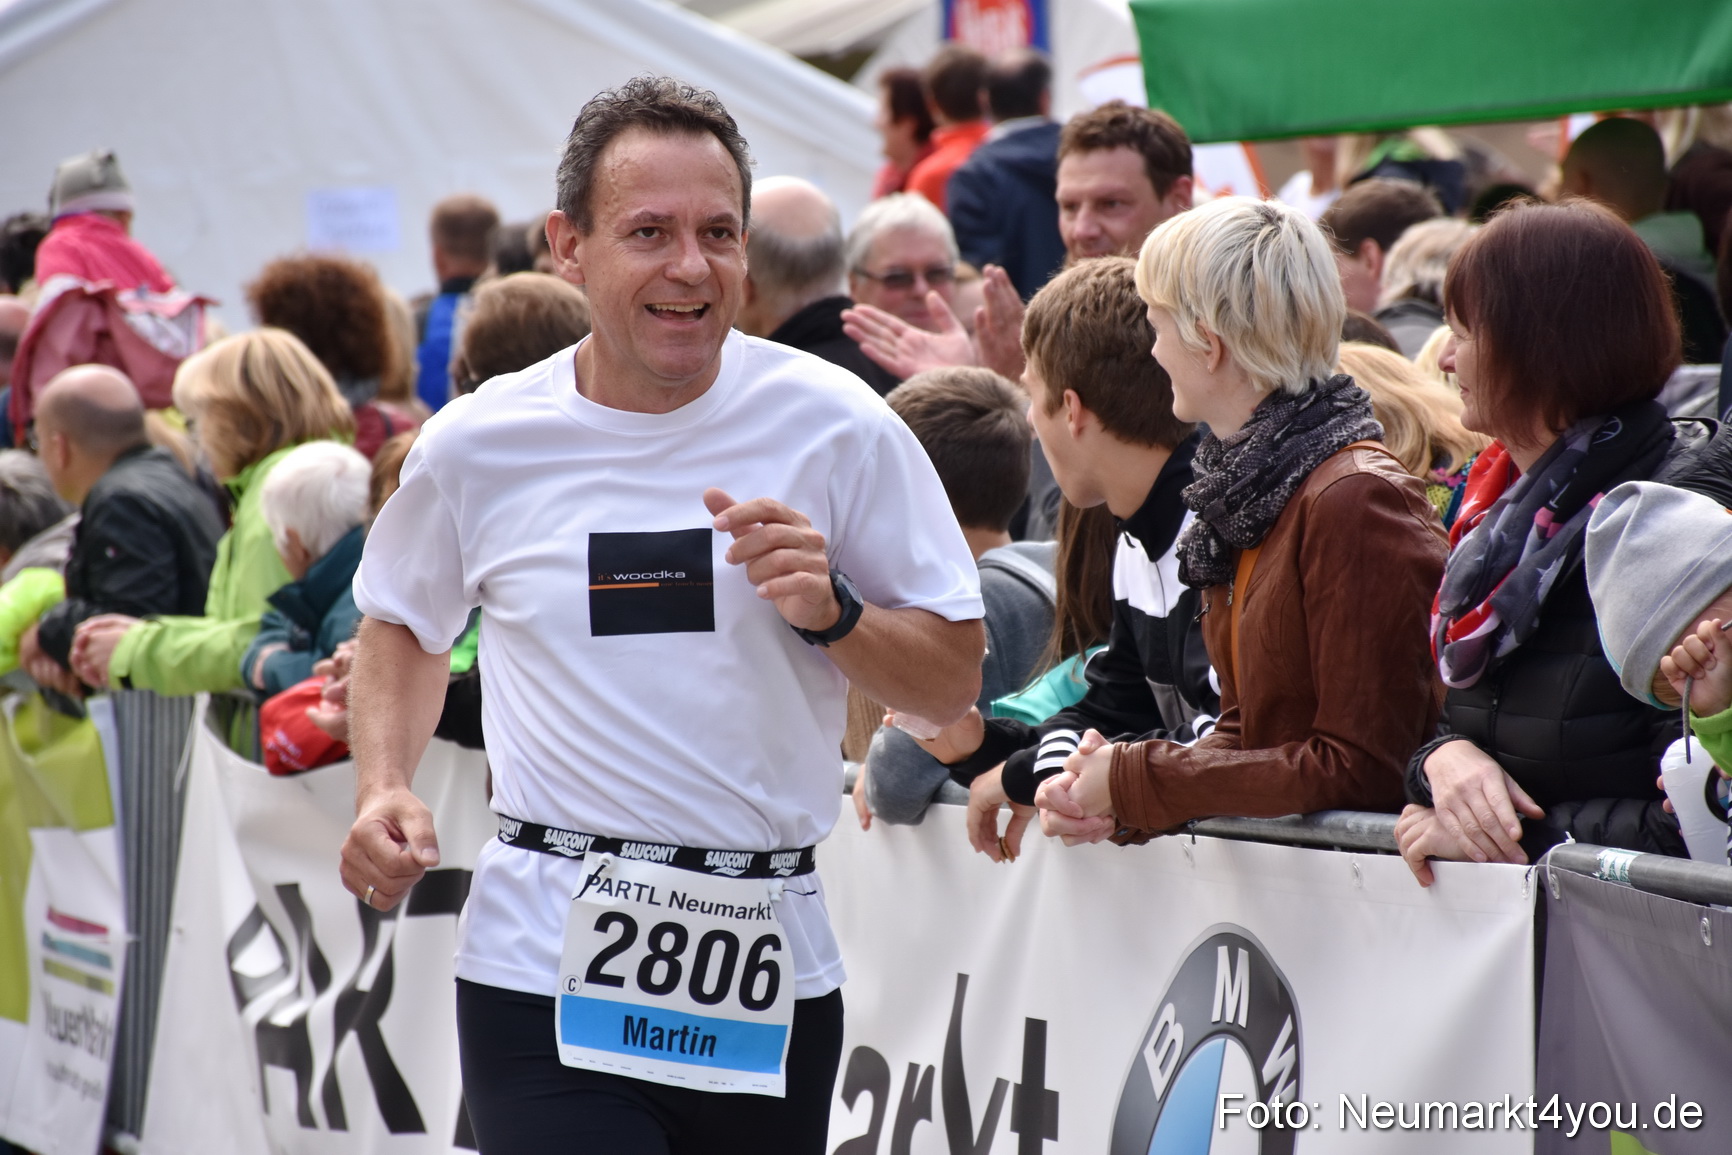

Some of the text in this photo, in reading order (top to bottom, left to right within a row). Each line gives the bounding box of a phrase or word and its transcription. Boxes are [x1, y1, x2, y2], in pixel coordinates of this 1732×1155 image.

[613, 570, 686, 580] woodka
[543, 828, 596, 851] SAUCONY
[620, 842, 679, 863] SAUCONY
[704, 850, 755, 869] SAUCONY
[769, 851, 803, 870] SAUCONY
[585, 874, 772, 920] PARTL Neumarkt
[584, 911, 782, 1012] 2806
[568, 978, 577, 992] C
[623, 1015, 717, 1058] Martin
[1143, 945, 1297, 1122] BMW
[834, 972, 1059, 1155] arkt
